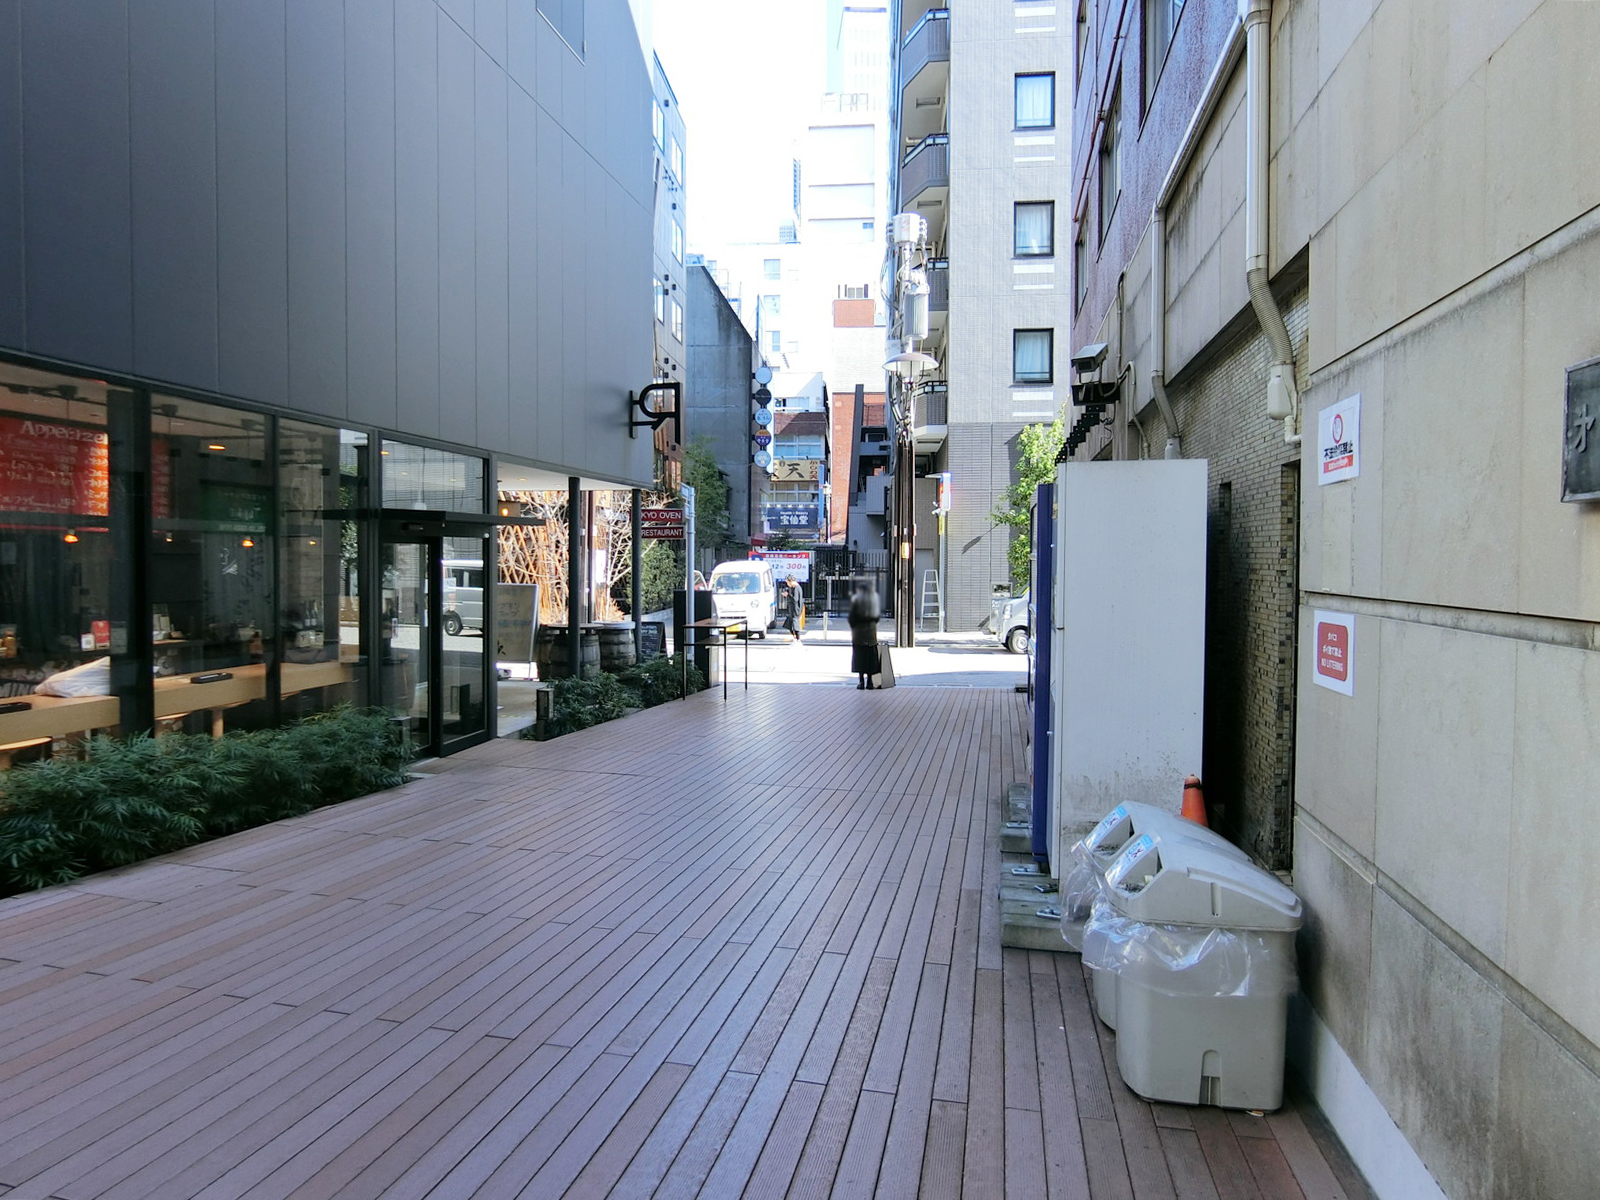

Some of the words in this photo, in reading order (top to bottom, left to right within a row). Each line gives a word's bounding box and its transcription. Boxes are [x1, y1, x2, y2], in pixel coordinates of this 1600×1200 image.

[659, 511, 682, 519] OVEN
[641, 529, 683, 537] RESTAURANT
[1321, 658, 1327, 668] NO
[1327, 659, 1344, 672] LITTERING
